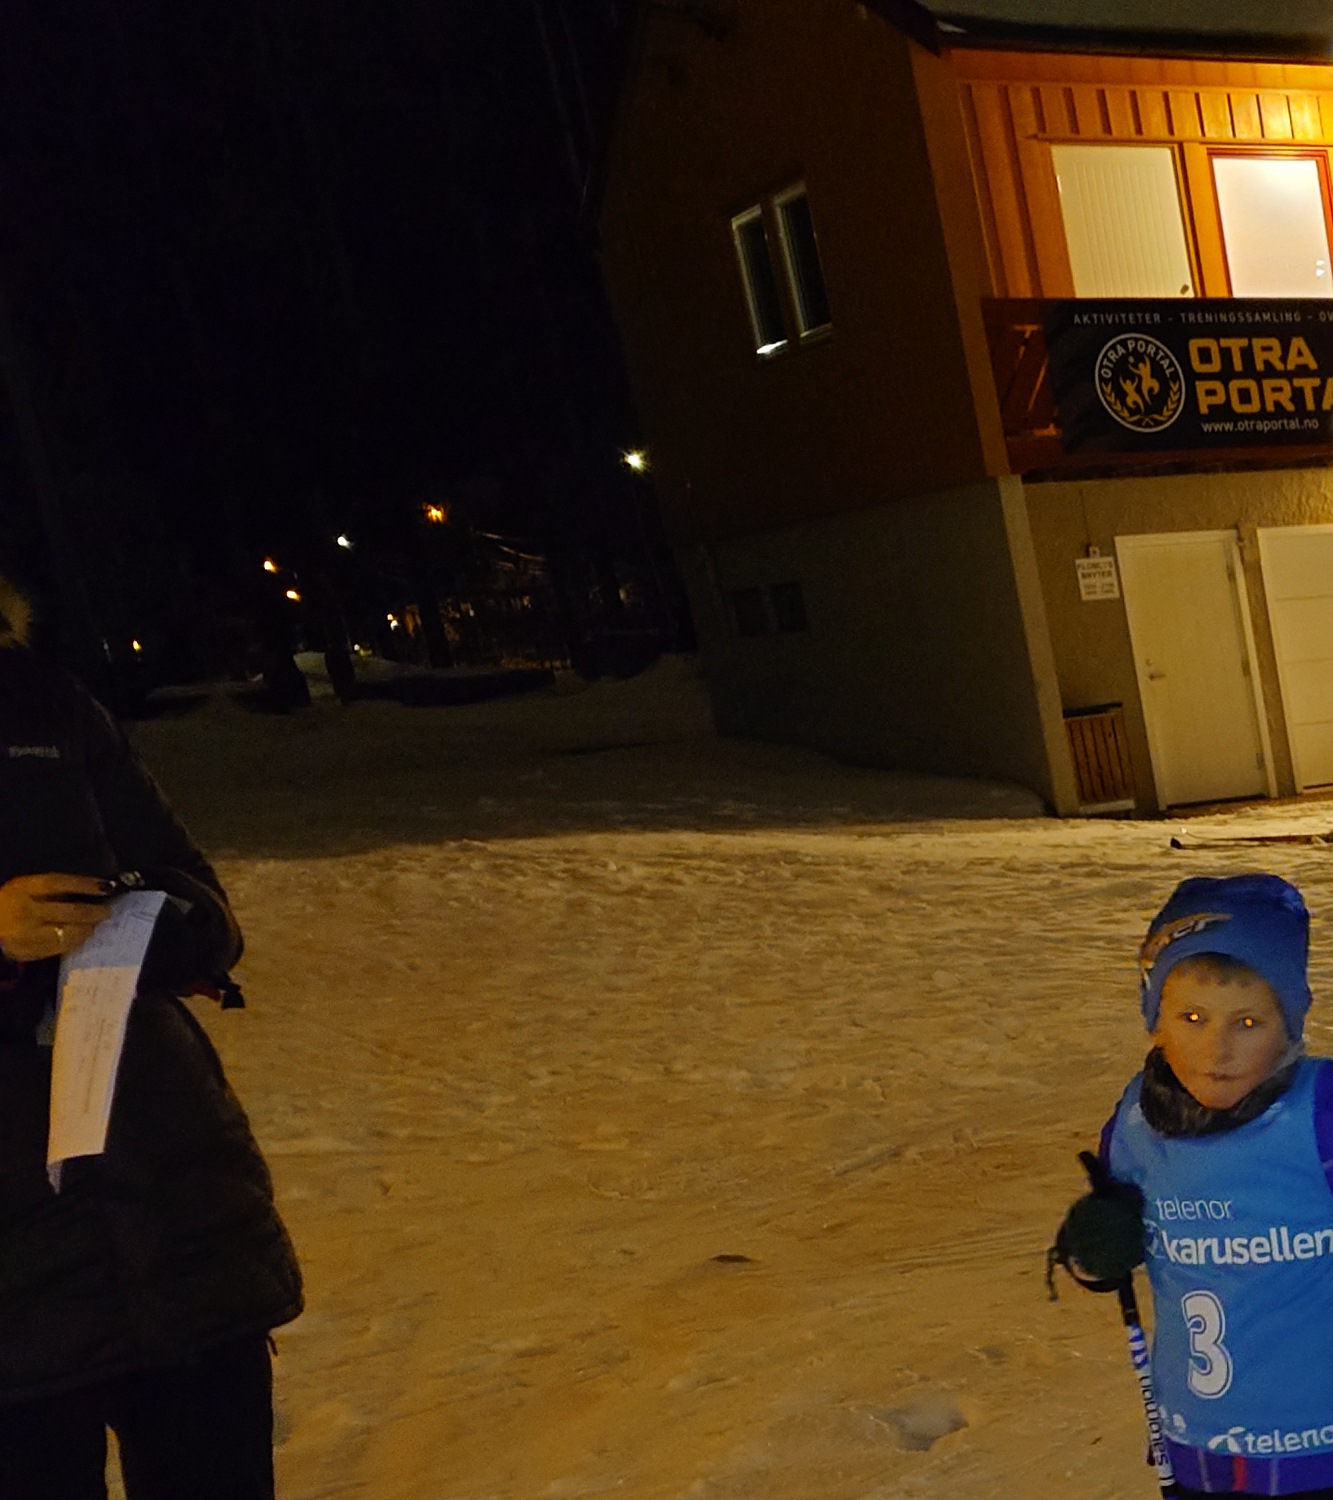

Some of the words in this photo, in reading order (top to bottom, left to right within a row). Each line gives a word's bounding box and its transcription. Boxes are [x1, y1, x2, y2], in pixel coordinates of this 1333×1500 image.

[1073, 313, 1161, 325] AKTIVITETER
[1180, 311, 1300, 324] TRENINGSSAMLING
[1100, 344, 1125, 379] OTRA
[1127, 340, 1176, 379] PORTAL
[1188, 337, 1319, 373] OTRA
[1201, 418, 1320, 433] www.otraportal.no
[1155, 1196, 1233, 1221] telenor
[1181, 1290, 1233, 1399] 3
